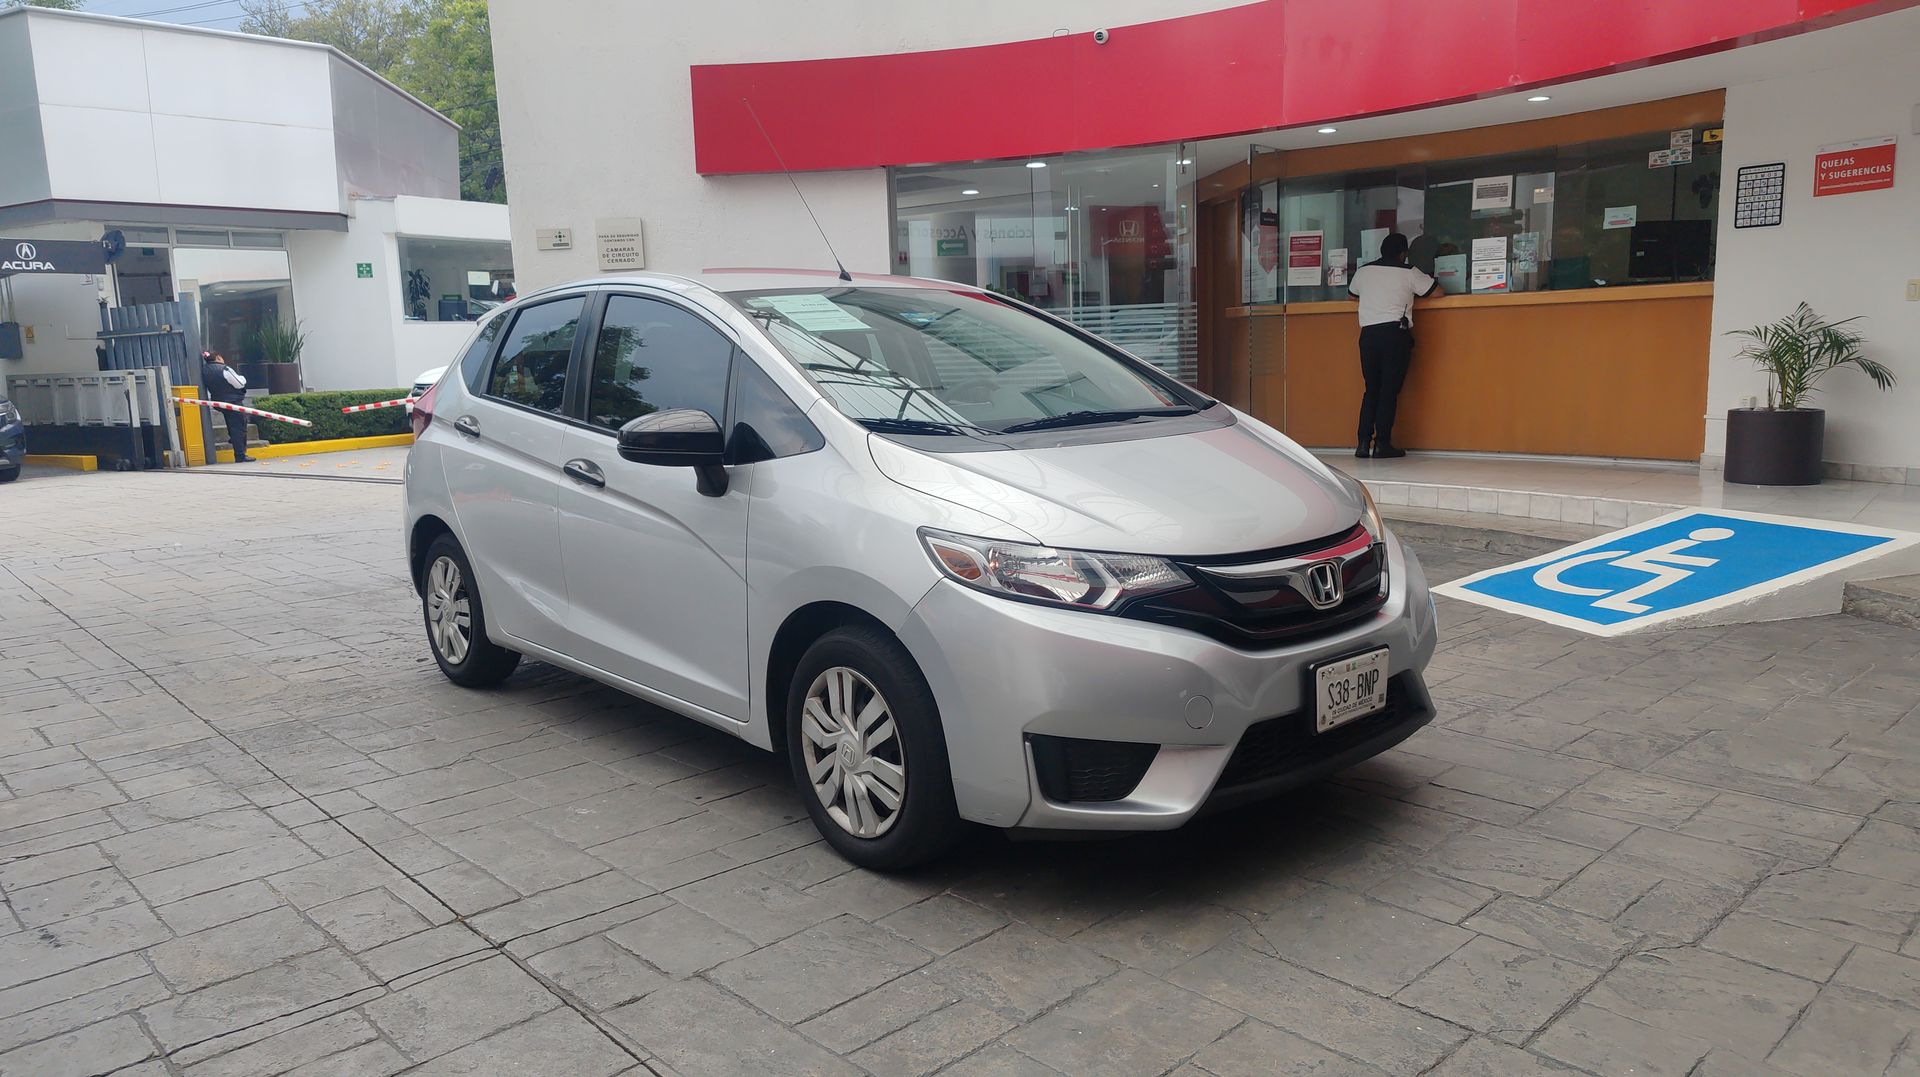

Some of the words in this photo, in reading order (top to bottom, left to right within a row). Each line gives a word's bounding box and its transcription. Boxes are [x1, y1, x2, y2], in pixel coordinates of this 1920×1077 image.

[1821, 156, 1855, 169] QUEJAS
[1820, 172, 1826, 181] Y
[1828, 164, 1892, 180] SUGERENCIAS
[1, 260, 55, 271] ACURA
[1328, 669, 1379, 709] S38-BNP
